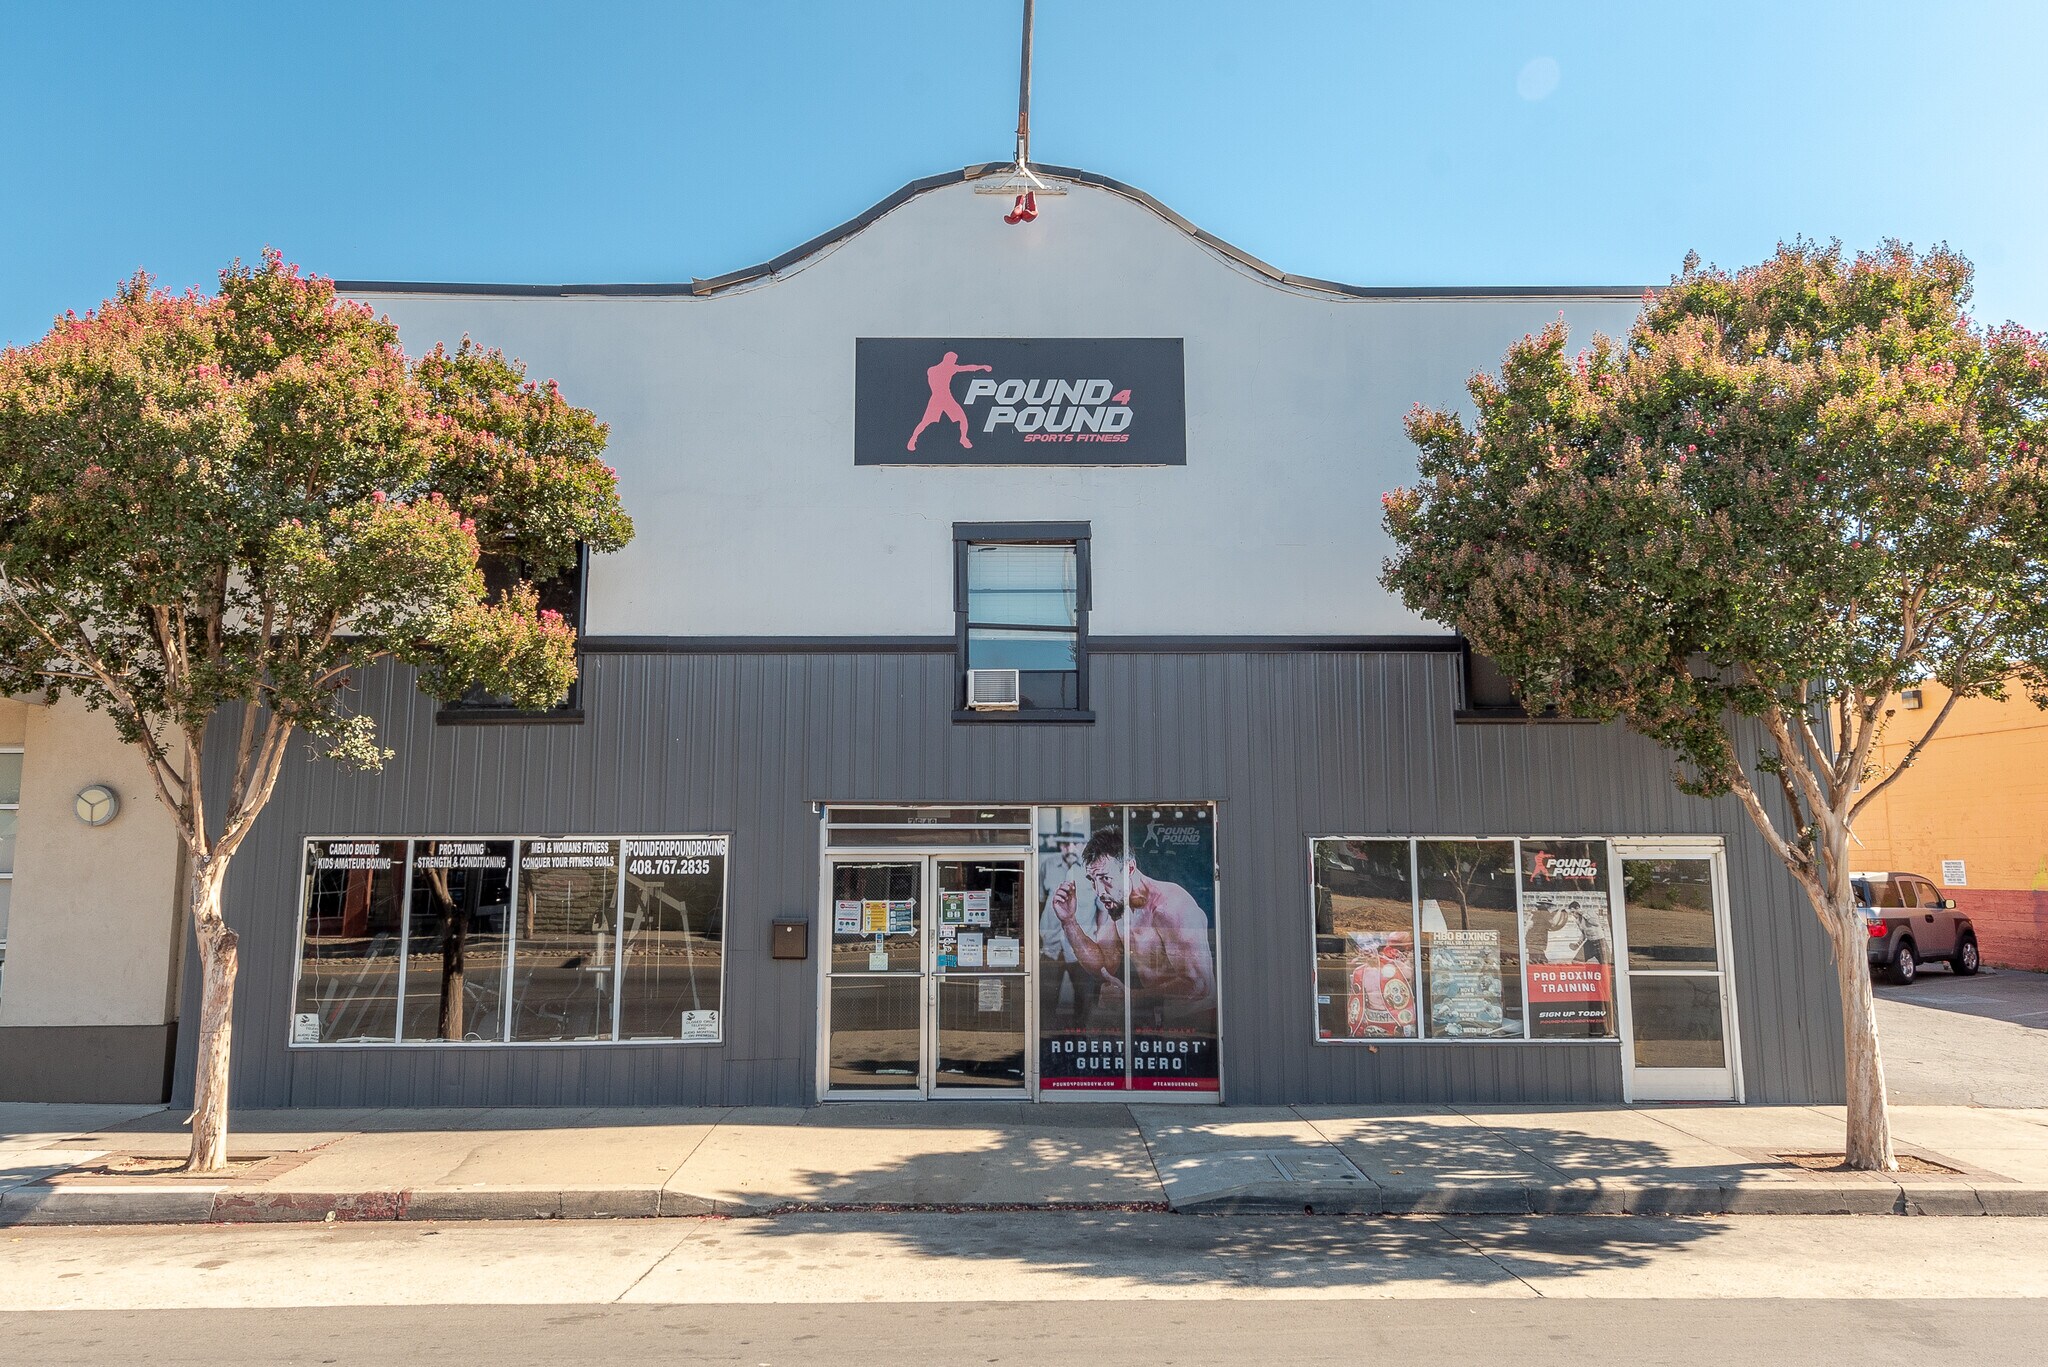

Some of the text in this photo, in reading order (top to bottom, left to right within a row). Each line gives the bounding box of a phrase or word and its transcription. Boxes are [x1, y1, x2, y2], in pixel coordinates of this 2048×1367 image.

[963, 379, 1132, 405] POUND 4
[982, 406, 1134, 433] POUND
[1023, 433, 1130, 443] SPORTS FITNESS
[1157, 827, 1195, 836] POUND
[1162, 835, 1201, 843] POUND
[329, 843, 380, 856] CARDIO BOXING
[438, 843, 485, 856] PRO-TRAINING
[531, 841, 609, 854] MEN & WOMANS FITNESS
[317, 857, 391, 870] KIDS AMATEUR BOXING
[417, 856, 506, 869] STRENGTH & CONDITIONING
[521, 856, 615, 868] CONQUER YOUR FITNESS GOALS
[629, 859, 710, 875] 408.767.2835
[1546, 858, 1591, 868] POUND
[1552, 867, 1597, 876] POUND
[1433, 931, 1498, 941] HBO BOXING'S
[1533, 971, 1602, 981] PRO BOXING
[1541, 983, 1596, 993] TRAINING
[1051, 1040, 1124, 1053] ROBERT
